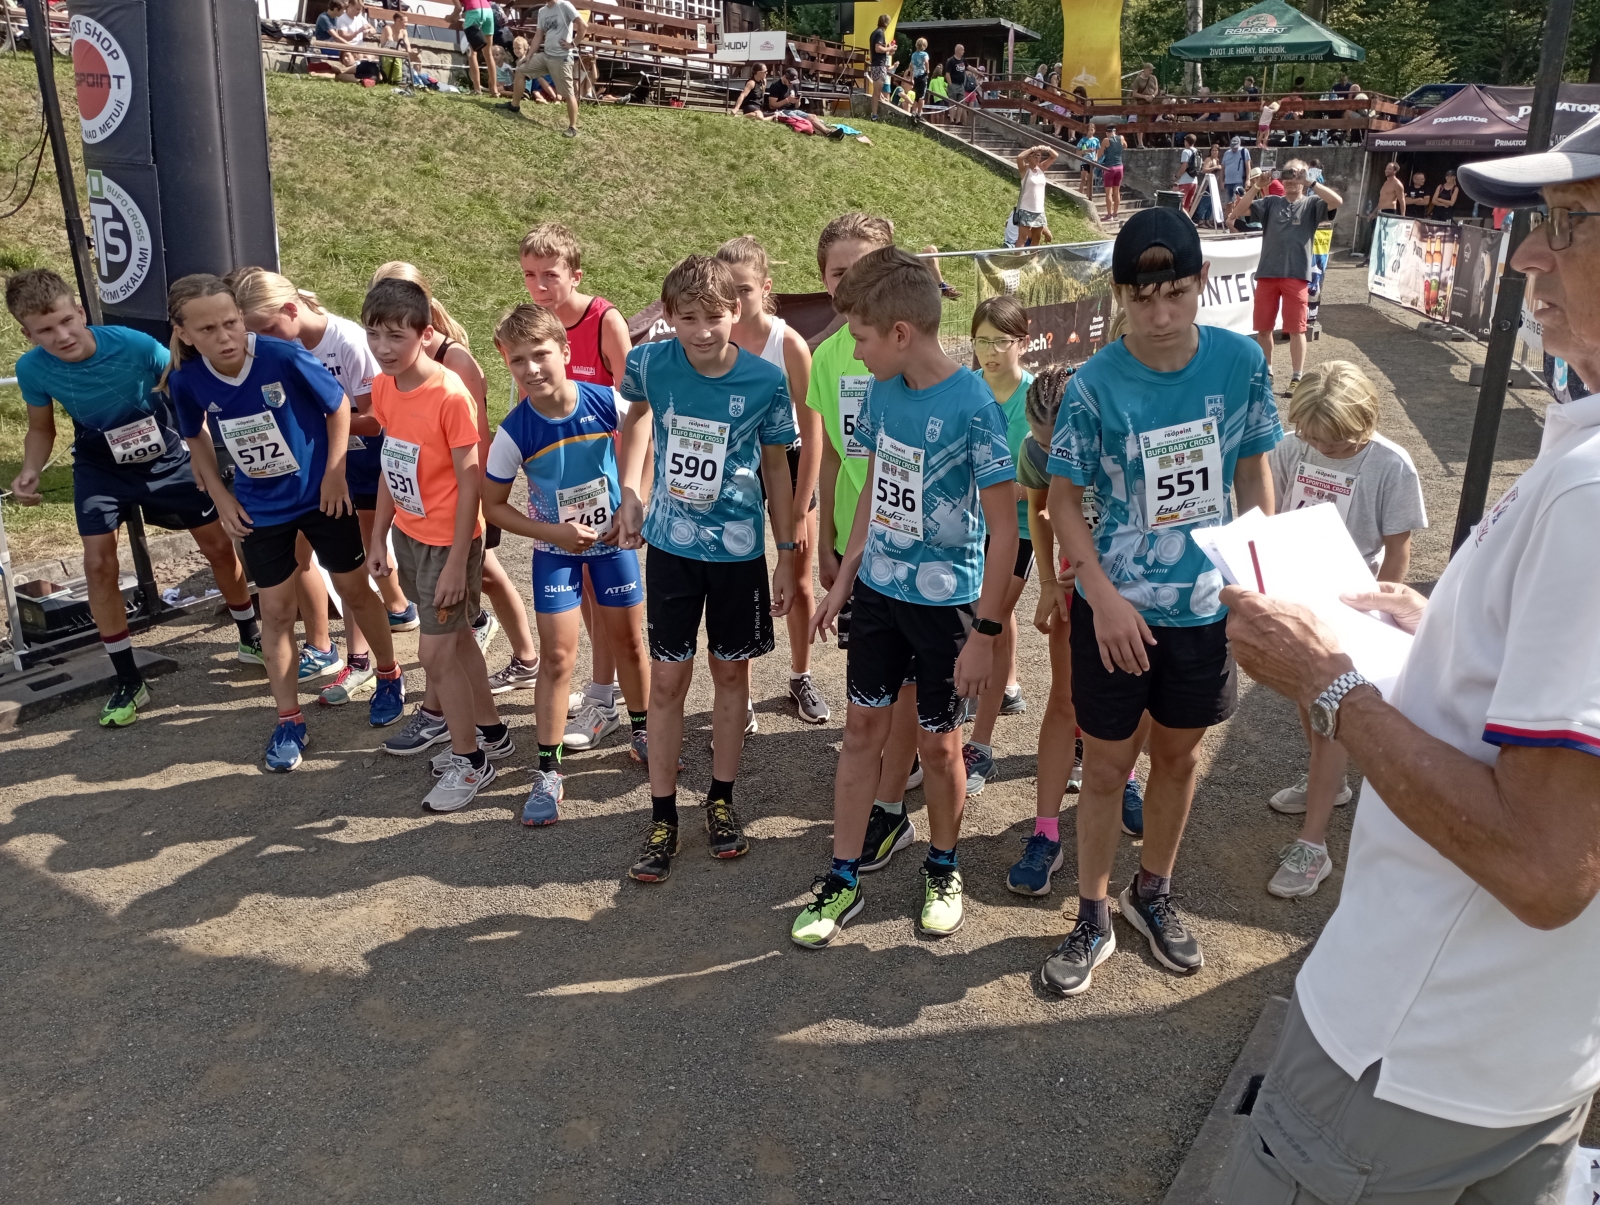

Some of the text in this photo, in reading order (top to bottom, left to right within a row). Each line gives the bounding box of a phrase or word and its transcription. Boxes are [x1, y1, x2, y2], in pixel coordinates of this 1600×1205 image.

[84, 22, 120, 60] SHOP
[724, 41, 748, 50] HUDY
[1210, 47, 1226, 56] ŽIVOT
[84, 98, 125, 140] NAD METUJÍ
[1432, 115, 1488, 125] PRIMATOR
[1375, 139, 1406, 147] PRIMATOR
[106, 184, 145, 242] BUFO CROSS
[120, 247, 148, 296] SKALAMI
[225, 431, 240, 439] BUFO
[240, 428, 255, 436] BABY
[255, 424, 274, 432] CROSS
[705, 435, 724, 444] CROSS
[1165, 427, 1191, 438] redpoint
[120, 443, 162, 462] 499
[238, 442, 285, 465] 572
[1147, 437, 1213, 457] BUFO BABY CROSS
[248, 460, 277, 472] bufo
[669, 452, 717, 481] 590
[878, 450, 919, 472] BUFO BABY CROSS
[1315, 470, 1337, 479] redpoint
[388, 471, 414, 496] 531
[670, 478, 703, 490] bufo
[1157, 467, 1209, 501] 551
[1305, 479, 1330, 489] SPORTIVA
[1332, 487, 1350, 495] CROSS
[589, 488, 606, 498] CROSS
[876, 477, 916, 512] 536
[876, 505, 906, 520] bufo
[1155, 497, 1200, 516] bufo
[564, 507, 607, 527] 48
[544, 582, 579, 593] SkiLauf
[604, 581, 637, 594] ATEX
